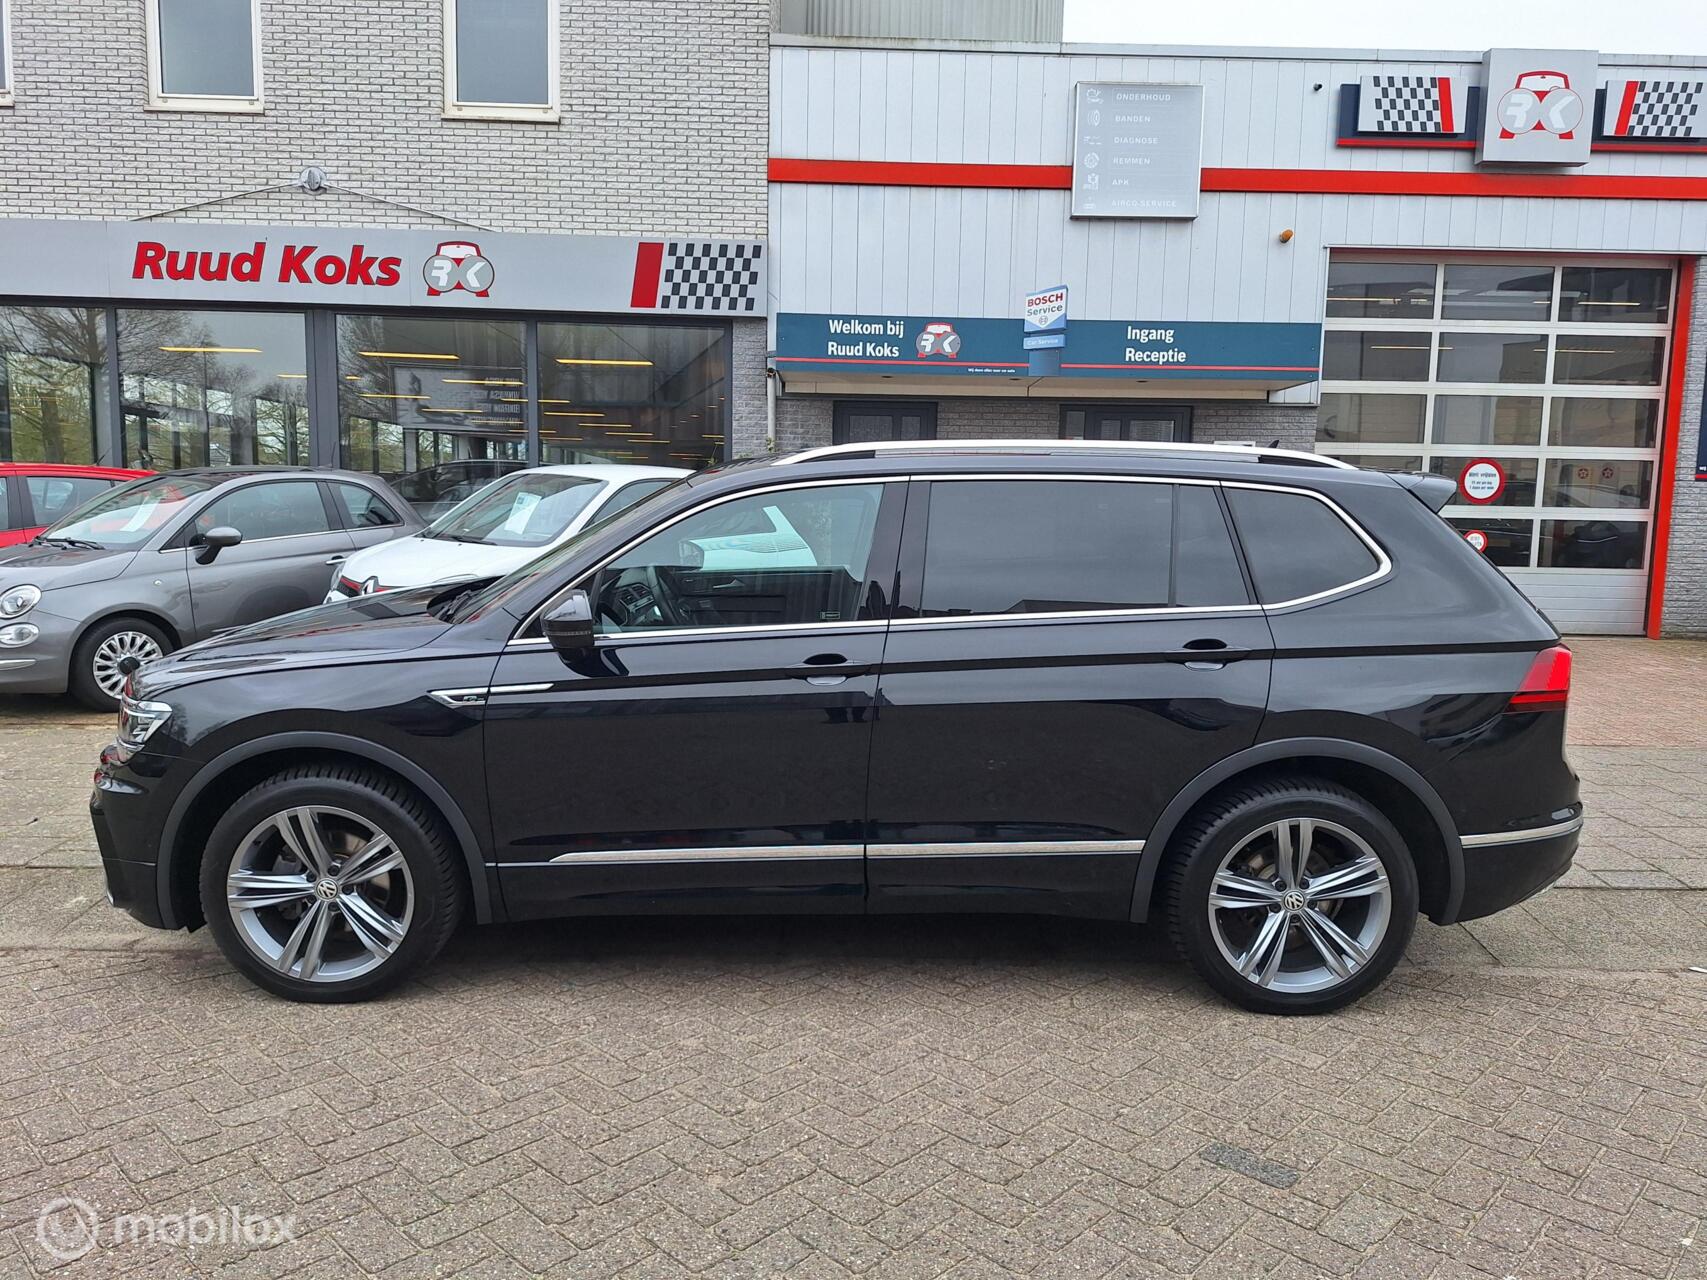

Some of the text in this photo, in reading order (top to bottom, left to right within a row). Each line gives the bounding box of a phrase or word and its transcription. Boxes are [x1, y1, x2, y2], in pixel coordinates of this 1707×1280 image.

[1116, 93, 1171, 101] ONDERHOUD
[1112, 157, 1151, 165] REMMEN
[131, 241, 402, 287] Ruud Koks
[1027, 292, 1064, 307] BOSCH
[1026, 304, 1063, 317] Service
[828, 319, 905, 338] Welkom bij
[1127, 325, 1175, 344] Ingang
[827, 341, 900, 358] Ruud Koks
[1125, 347, 1187, 366] Receptie
